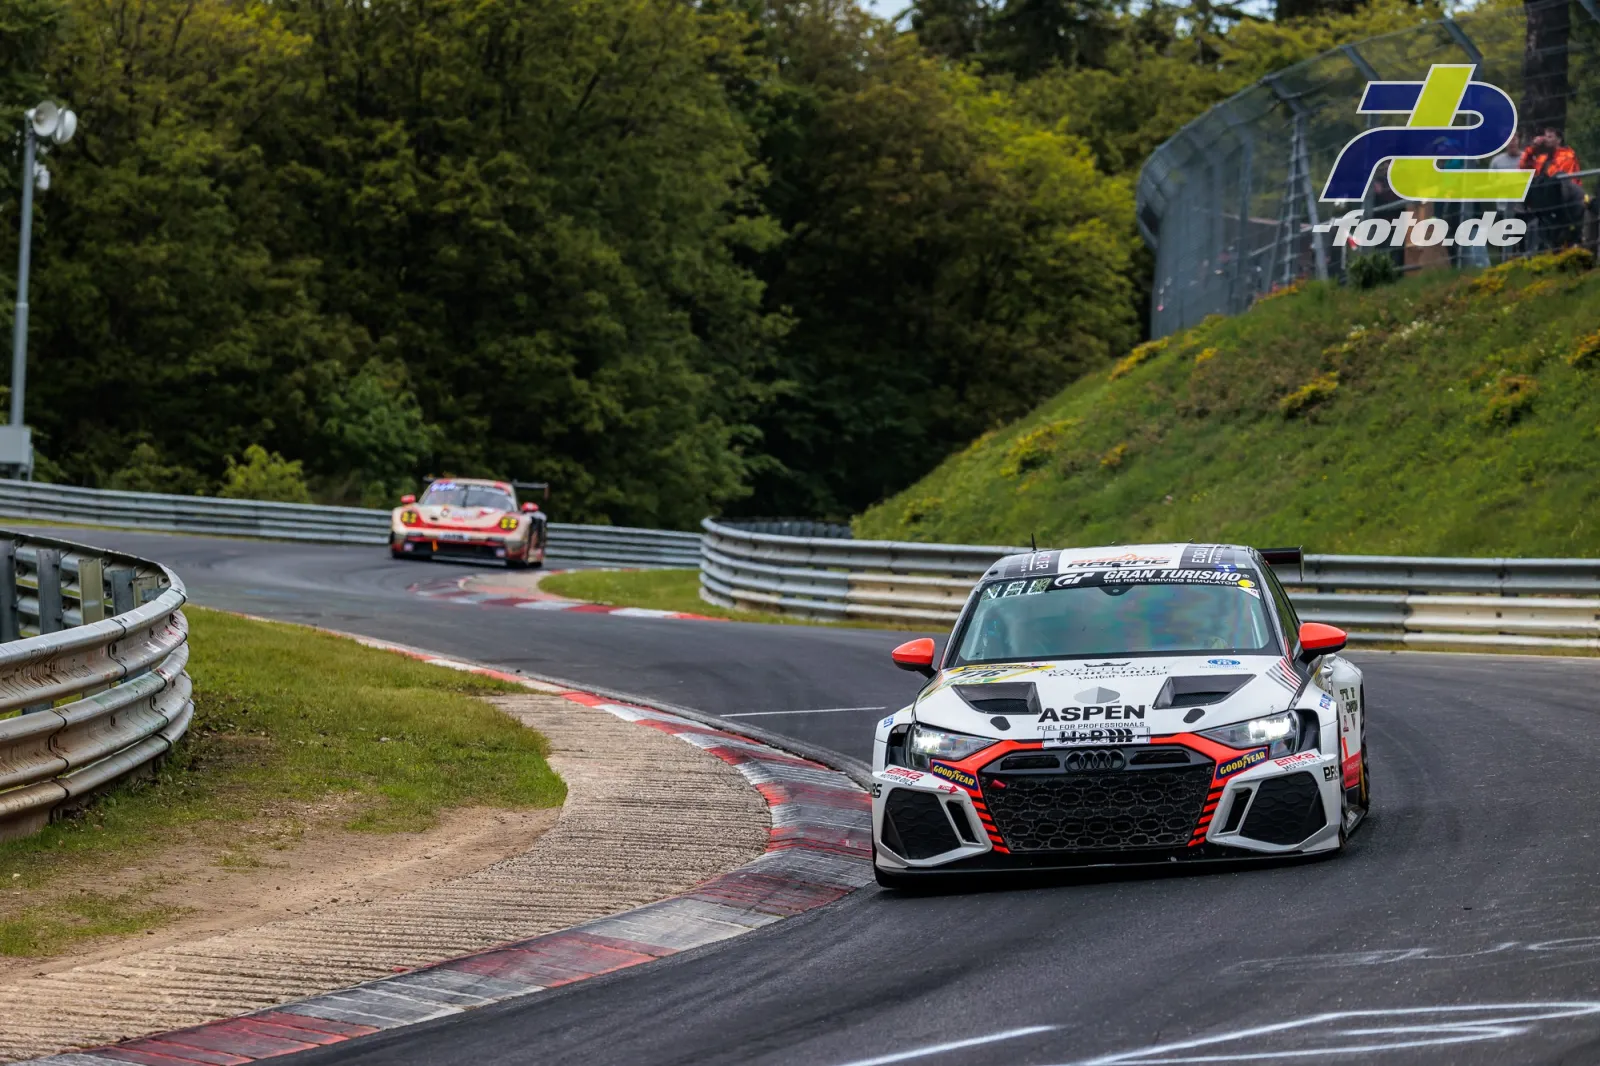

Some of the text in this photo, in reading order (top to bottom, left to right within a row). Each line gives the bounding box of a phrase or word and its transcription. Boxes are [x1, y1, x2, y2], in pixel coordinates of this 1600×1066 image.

[1103, 569, 1242, 582] GRAN TURISMO
[1038, 704, 1146, 723] ASPEN
[1077, 721, 1145, 730] PROFESSIONALS
